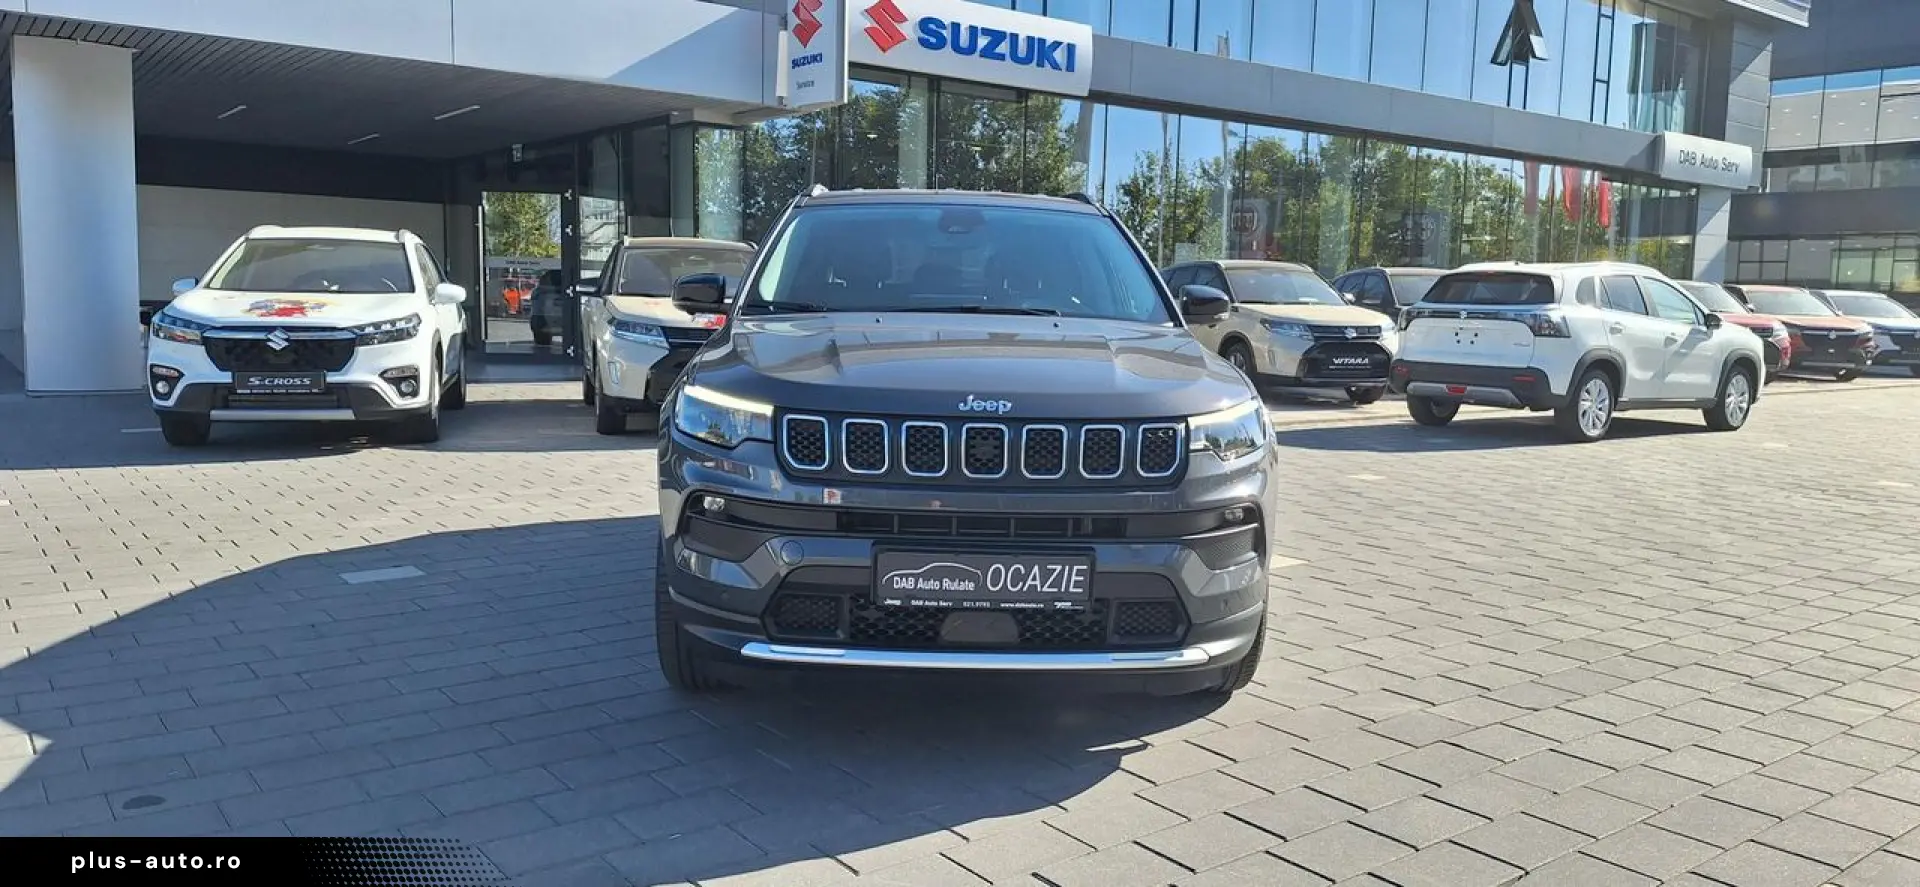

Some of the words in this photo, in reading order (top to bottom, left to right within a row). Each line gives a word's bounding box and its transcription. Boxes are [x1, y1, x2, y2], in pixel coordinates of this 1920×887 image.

[916, 15, 1076, 73] SUZUKI
[791, 52, 823, 69] SUZUKI
[1679, 149, 1697, 166] DAB
[1700, 153, 1719, 170] Auto
[1721, 157, 1741, 173] Serv
[958, 393, 1012, 415] Jeep
[893, 577, 916, 589] DAB
[917, 577, 940, 590] Auto
[942, 577, 976, 591] Rulate
[986, 563, 1088, 592] OCAZIE
